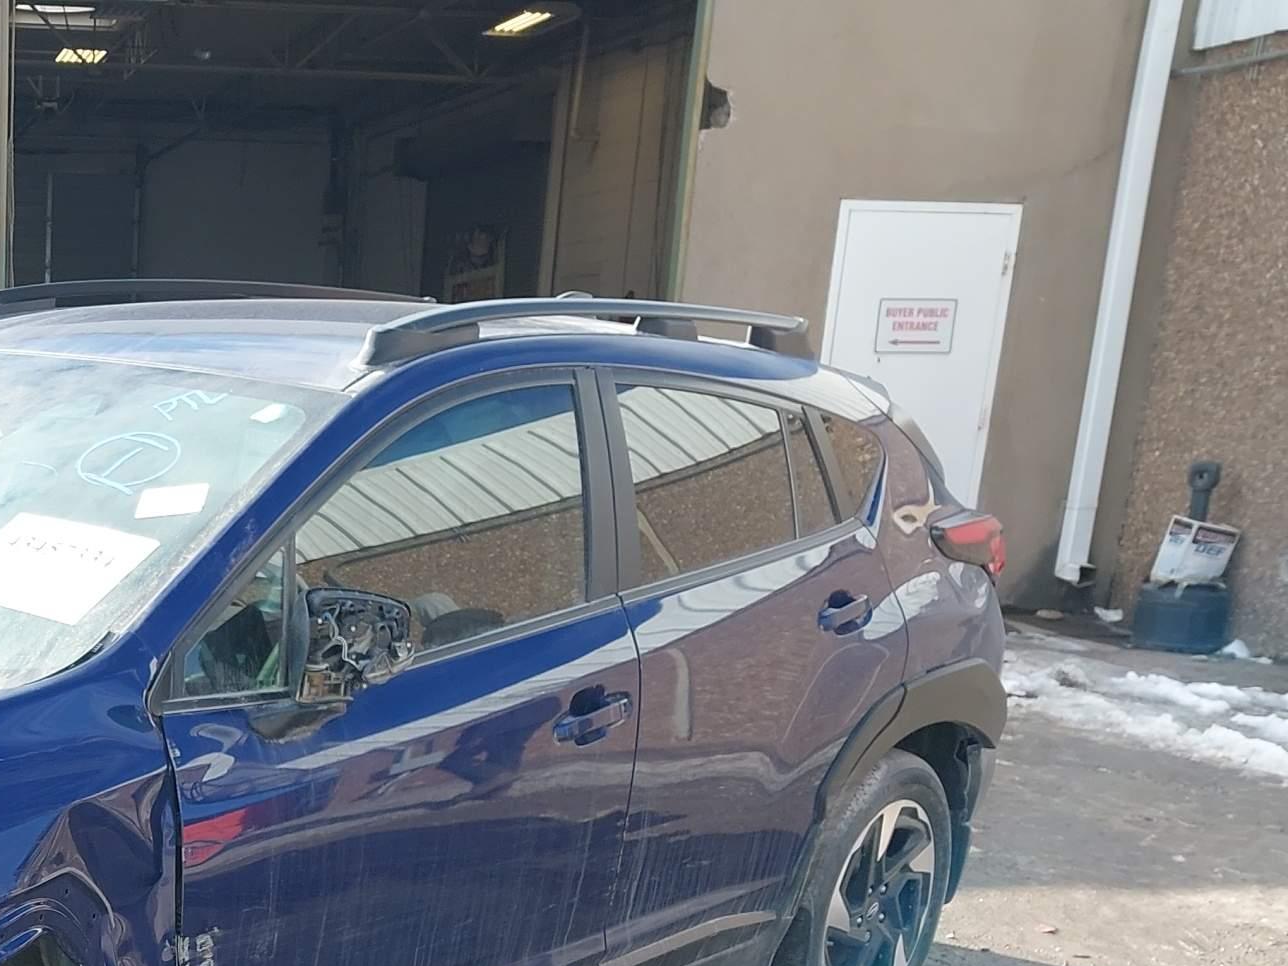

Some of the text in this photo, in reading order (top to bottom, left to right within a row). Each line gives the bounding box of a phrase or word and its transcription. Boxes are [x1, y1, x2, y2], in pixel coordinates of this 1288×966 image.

[885, 307, 950, 318] BUYER PUBLIC
[891, 321, 939, 332] ENTRANCE
